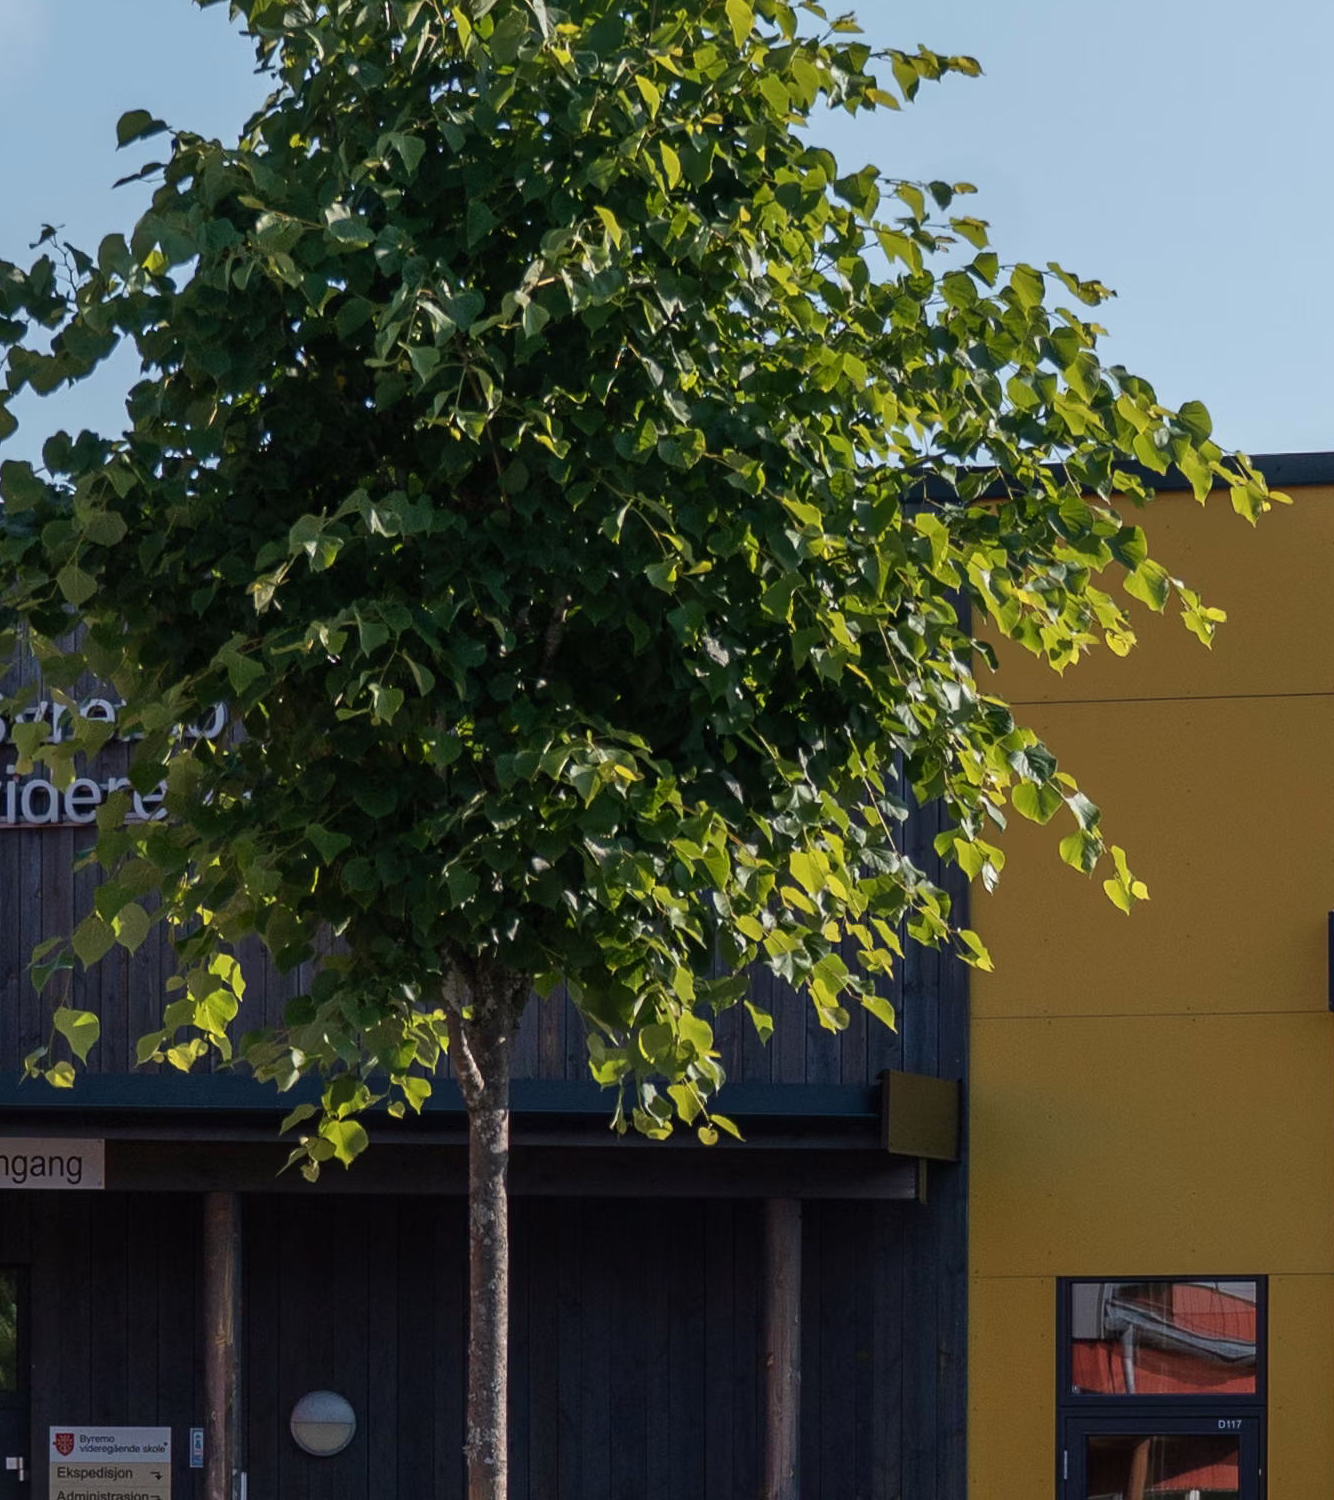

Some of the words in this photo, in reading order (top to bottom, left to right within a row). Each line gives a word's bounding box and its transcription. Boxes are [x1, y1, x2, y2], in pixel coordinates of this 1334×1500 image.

[1218, 1419, 1242, 1429] D117
[79, 1434, 116, 1444] Byremo
[79, 1445, 141, 1455] videregående
[142, 1445, 166, 1453] skole
[56, 1466, 133, 1481] Ekspedisjon
